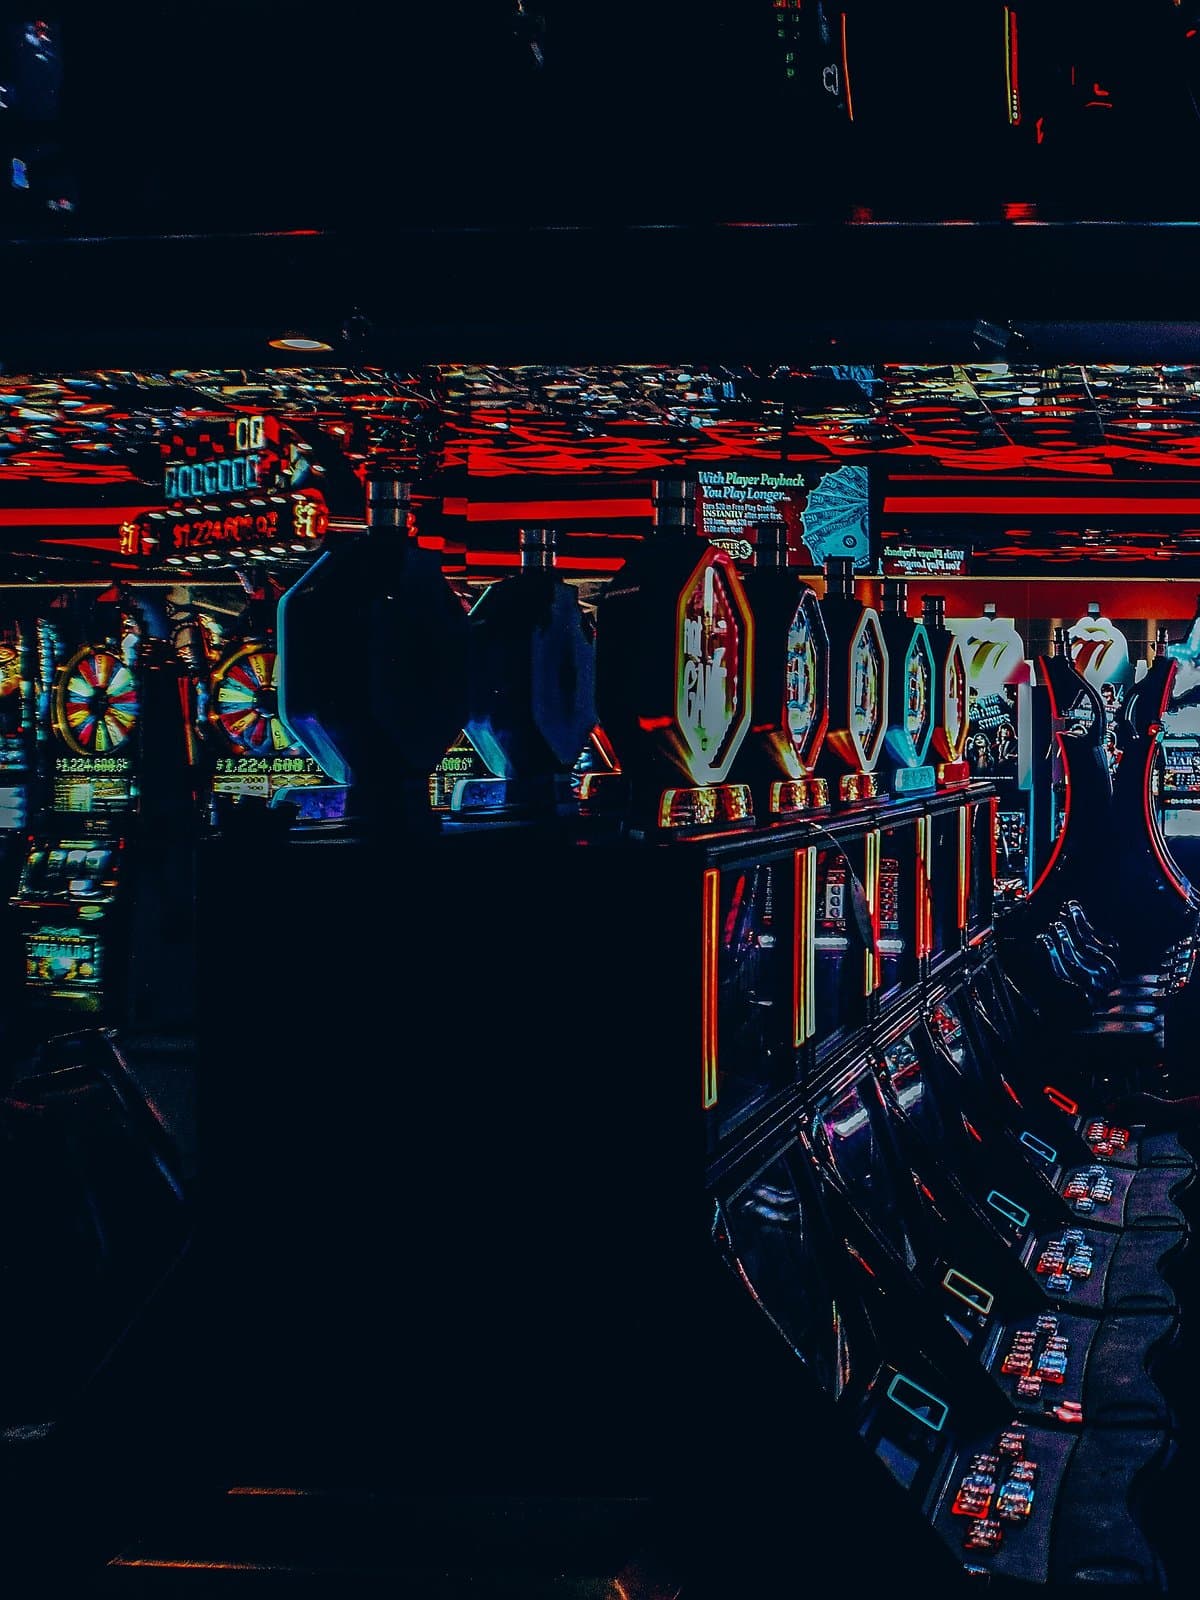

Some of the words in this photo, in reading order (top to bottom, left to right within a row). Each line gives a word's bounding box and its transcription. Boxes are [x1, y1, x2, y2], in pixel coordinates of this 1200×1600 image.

[698, 471, 724, 485] With
[725, 472, 760, 488] Player
[760, 473, 805, 490] Payback
[702, 486, 723, 498] You
[723, 486, 746, 503] Play
[703, 510, 743, 519] INSTANTLY
[983, 693, 1000, 705] THE
[978, 713, 1010, 730] STONES
